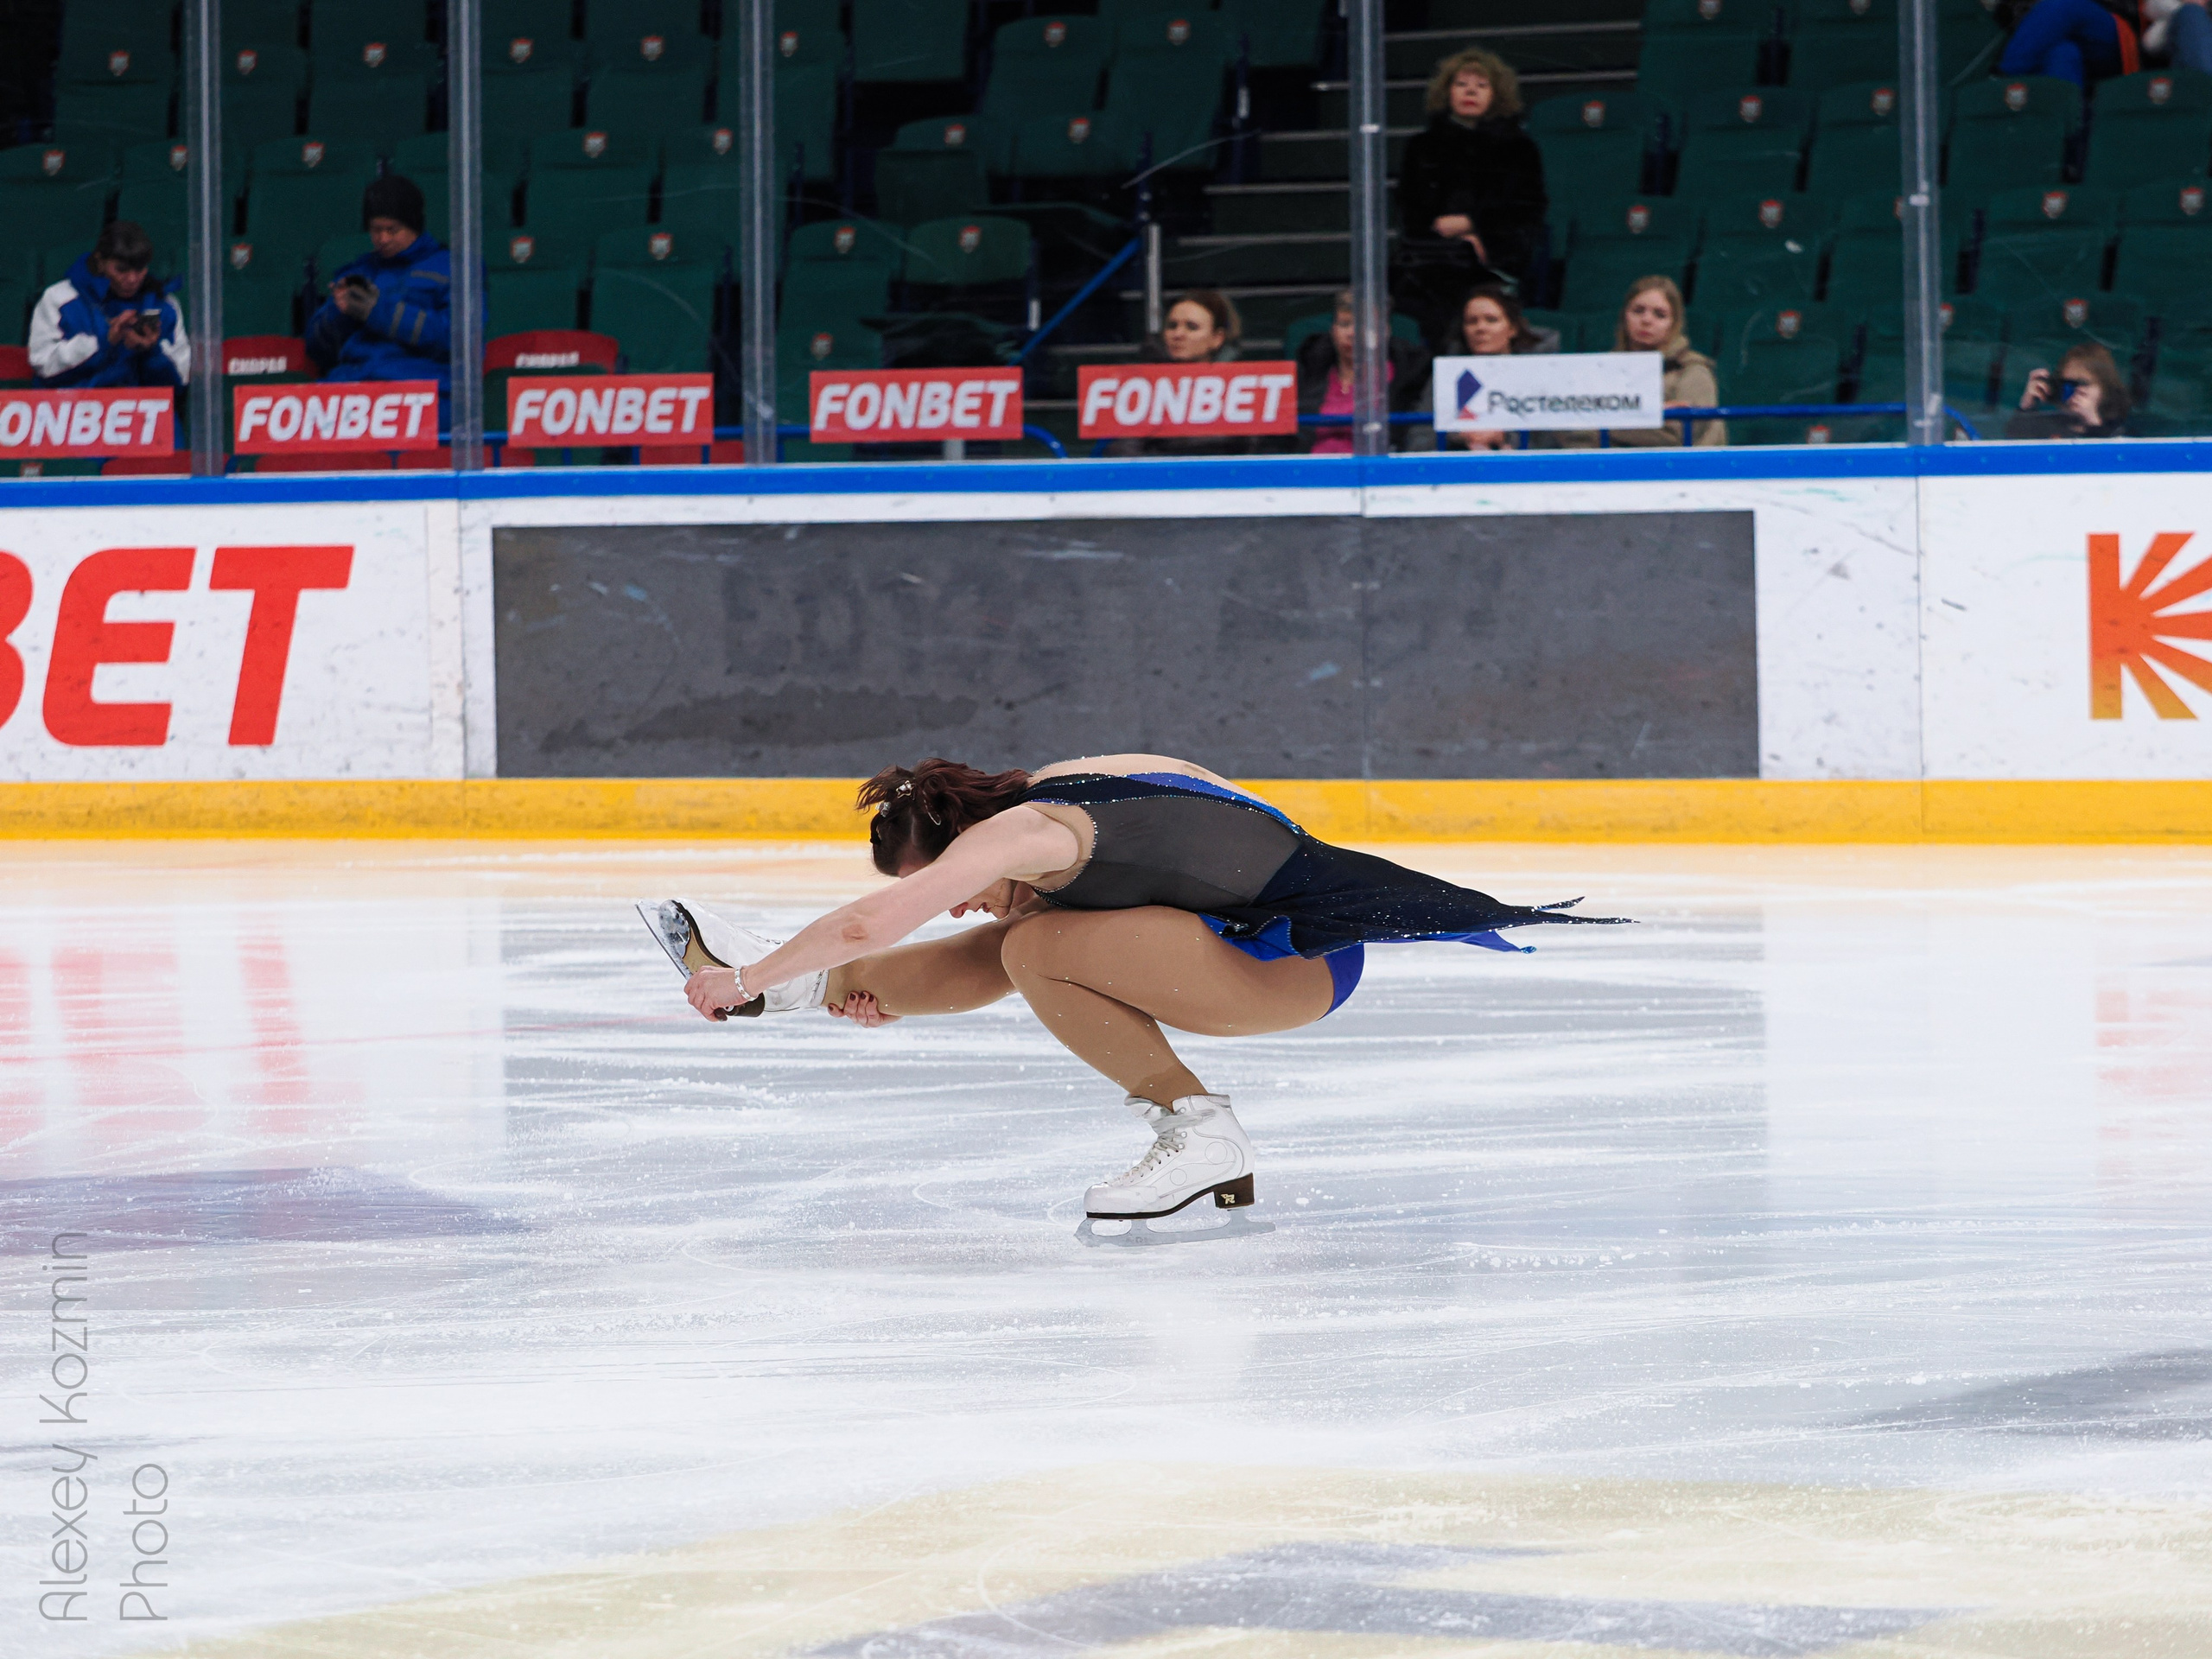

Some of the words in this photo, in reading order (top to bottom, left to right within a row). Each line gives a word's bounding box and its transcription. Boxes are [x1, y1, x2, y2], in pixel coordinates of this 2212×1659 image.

[0, 399, 170, 447] ONBET
[238, 392, 435, 442] FONBET
[512, 386, 709, 435] FONBET
[814, 380, 1019, 430] FONBET
[1084, 374, 1294, 426] FONBET
[1487, 391, 1641, 416] Ростелеком
